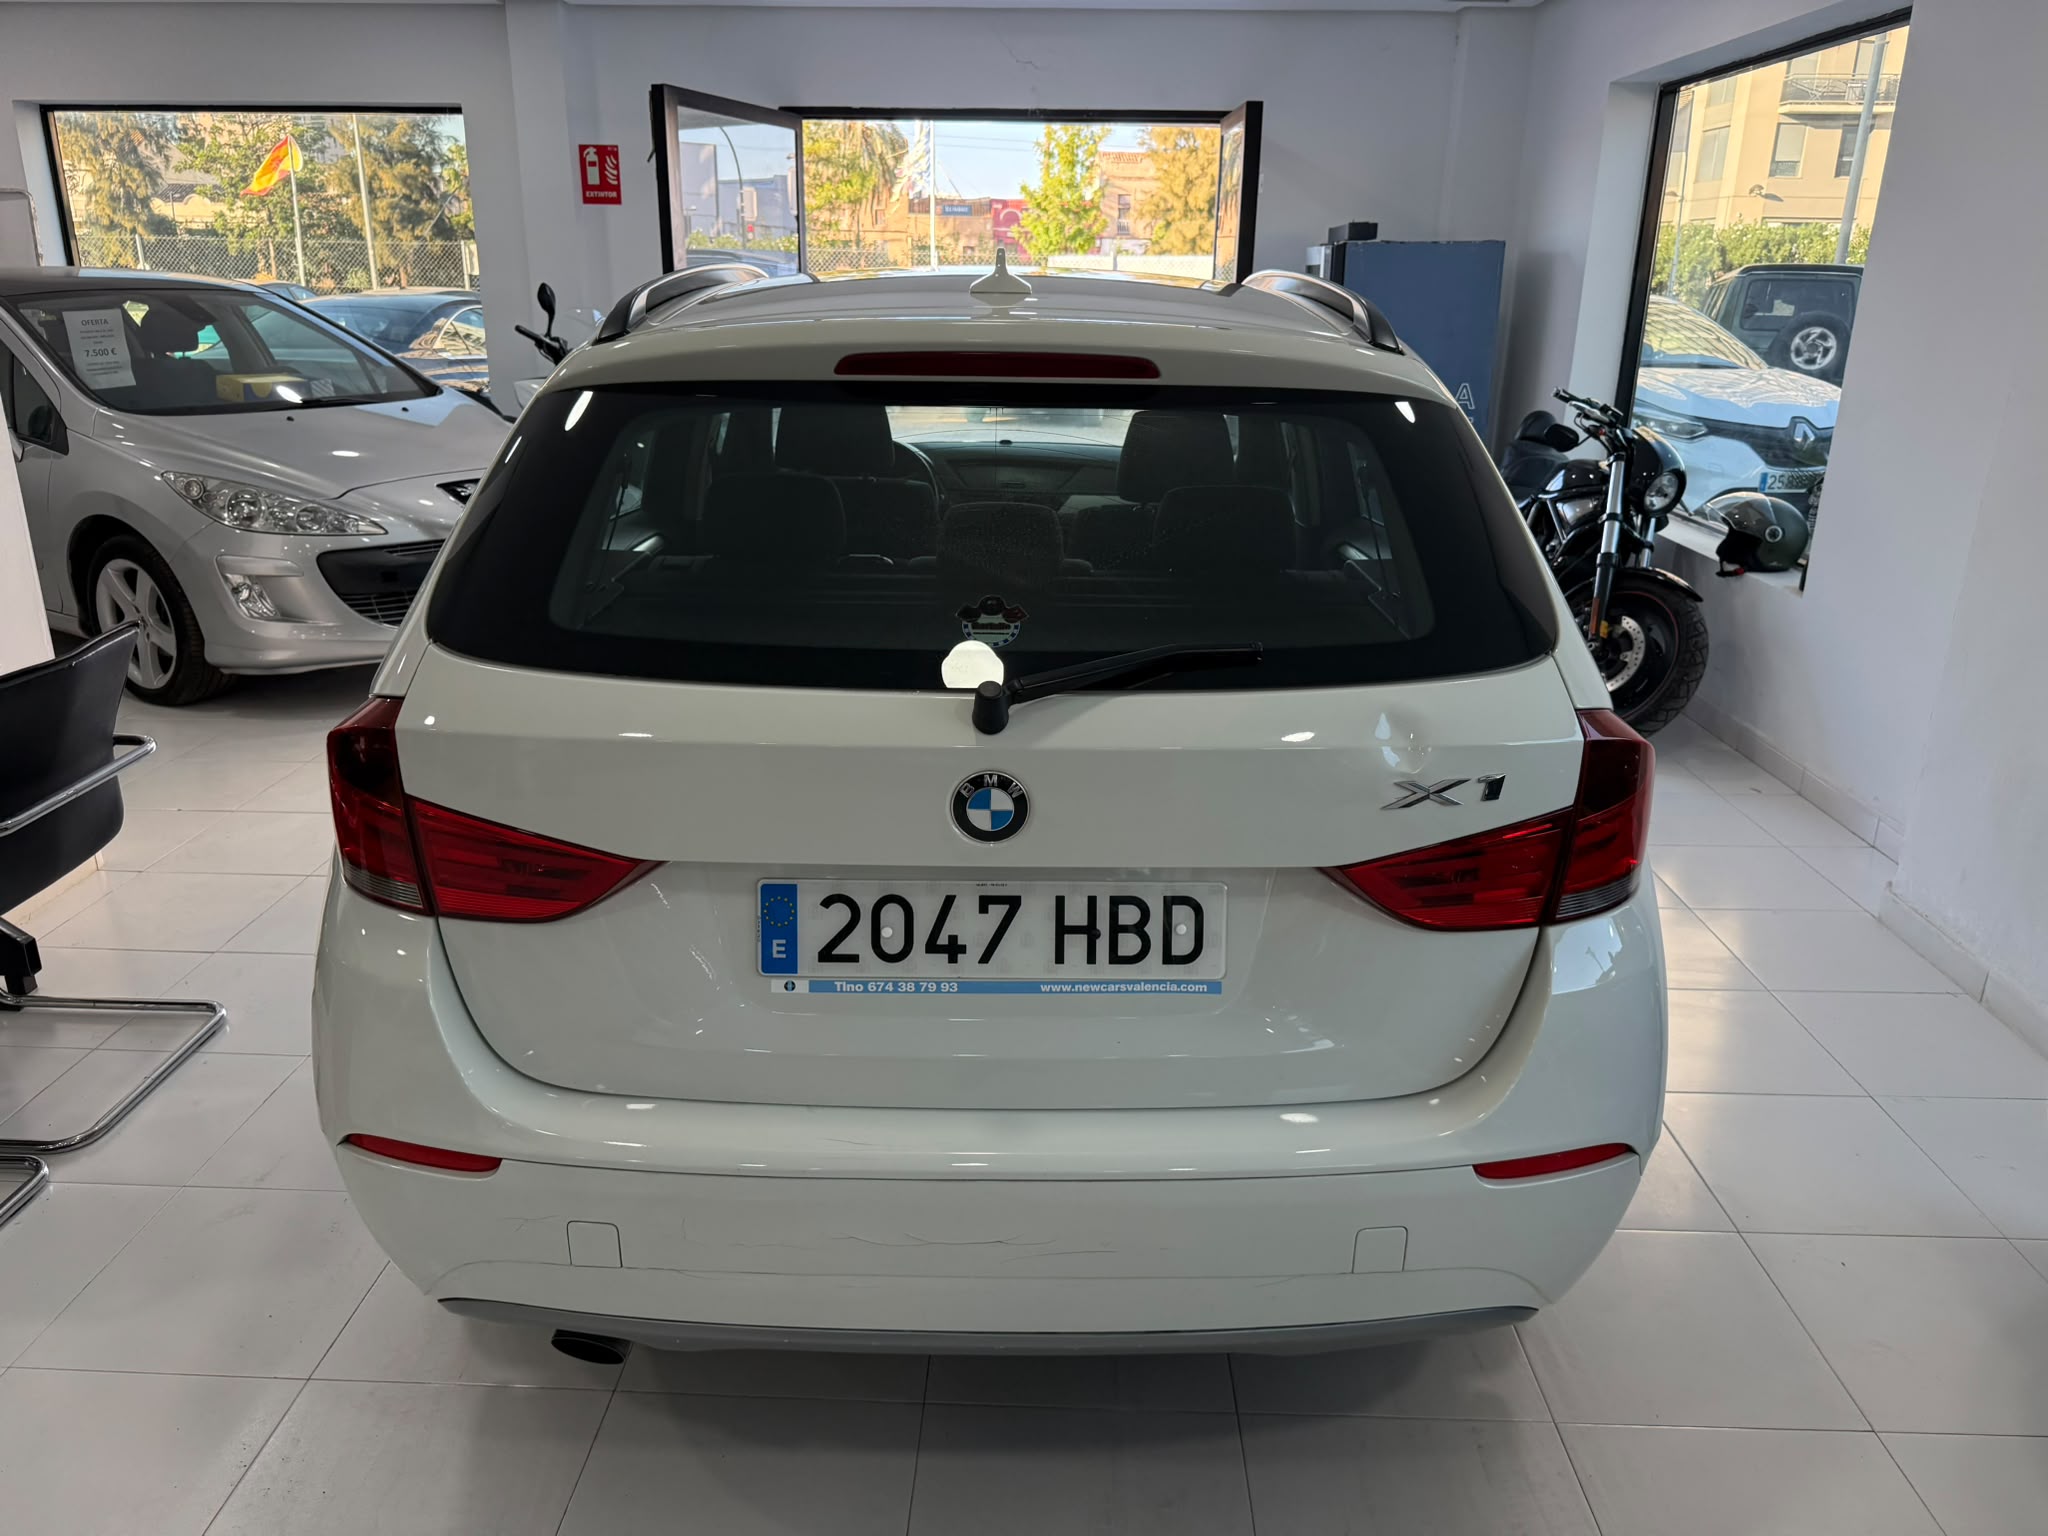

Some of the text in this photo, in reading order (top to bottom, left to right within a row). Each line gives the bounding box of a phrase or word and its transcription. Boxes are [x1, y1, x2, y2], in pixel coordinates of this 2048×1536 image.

[84, 347, 118, 357] 7.500 €
[960, 774, 1023, 798] BMW
[1380, 774, 1507, 809] X1
[818, 893, 1204, 965] 2047 HBD
[772, 939, 787, 958] E
[867, 982, 894, 992] 674
[897, 982, 916, 993] 38
[919, 982, 937, 993] 79
[940, 982, 958, 993] 93
[1040, 981, 1208, 992] www.newcarsvalencia.com
